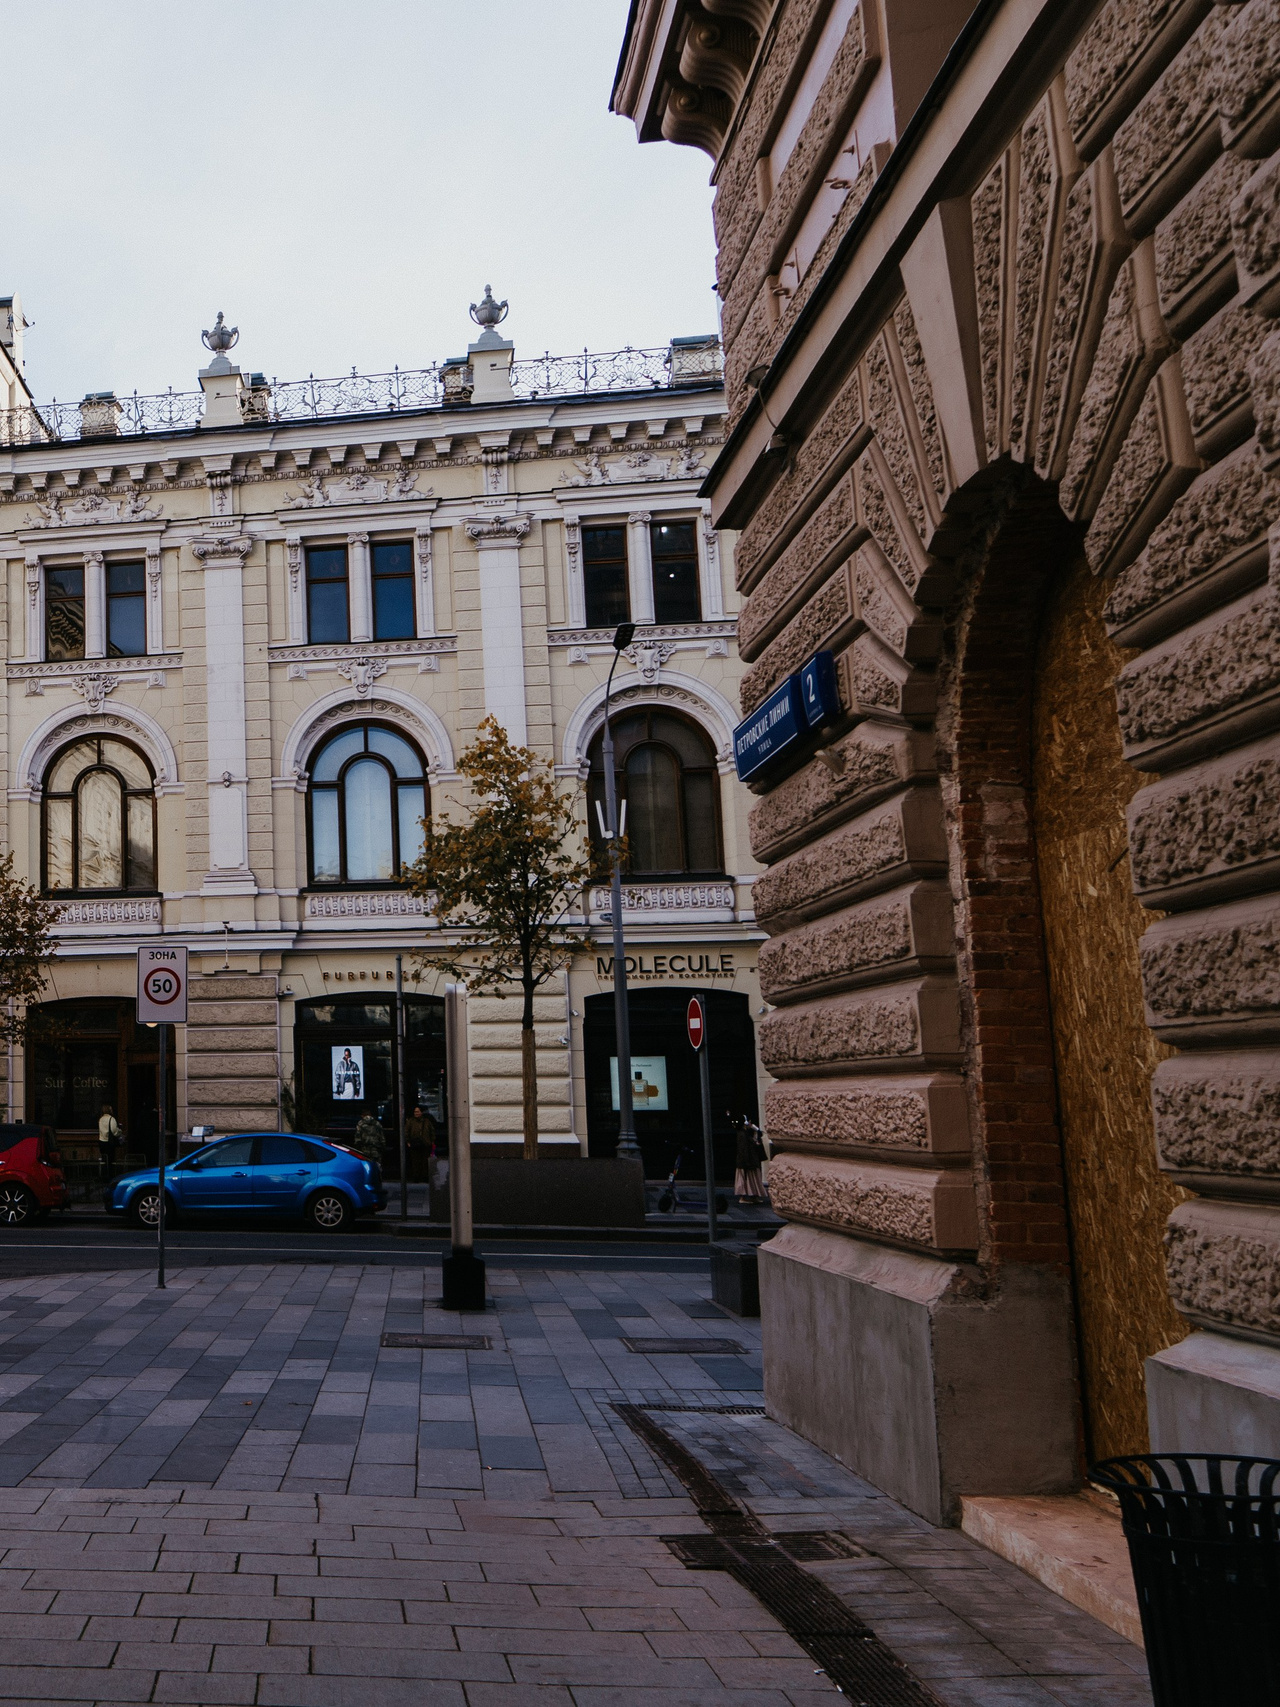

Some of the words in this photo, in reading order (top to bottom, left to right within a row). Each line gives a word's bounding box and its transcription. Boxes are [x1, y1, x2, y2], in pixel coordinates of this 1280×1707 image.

[806, 673, 815, 703] 2
[737, 714, 769, 755] ПЕТРОВСКИЕ
[769, 695, 790, 728] ЛИНИИ
[148, 951, 177, 960] ЗОНА
[596, 954, 734, 975] MOLECULE
[322, 970, 407, 980] FURFUR
[152, 979, 173, 993] 50
[72, 1077, 108, 1089] Coffee
